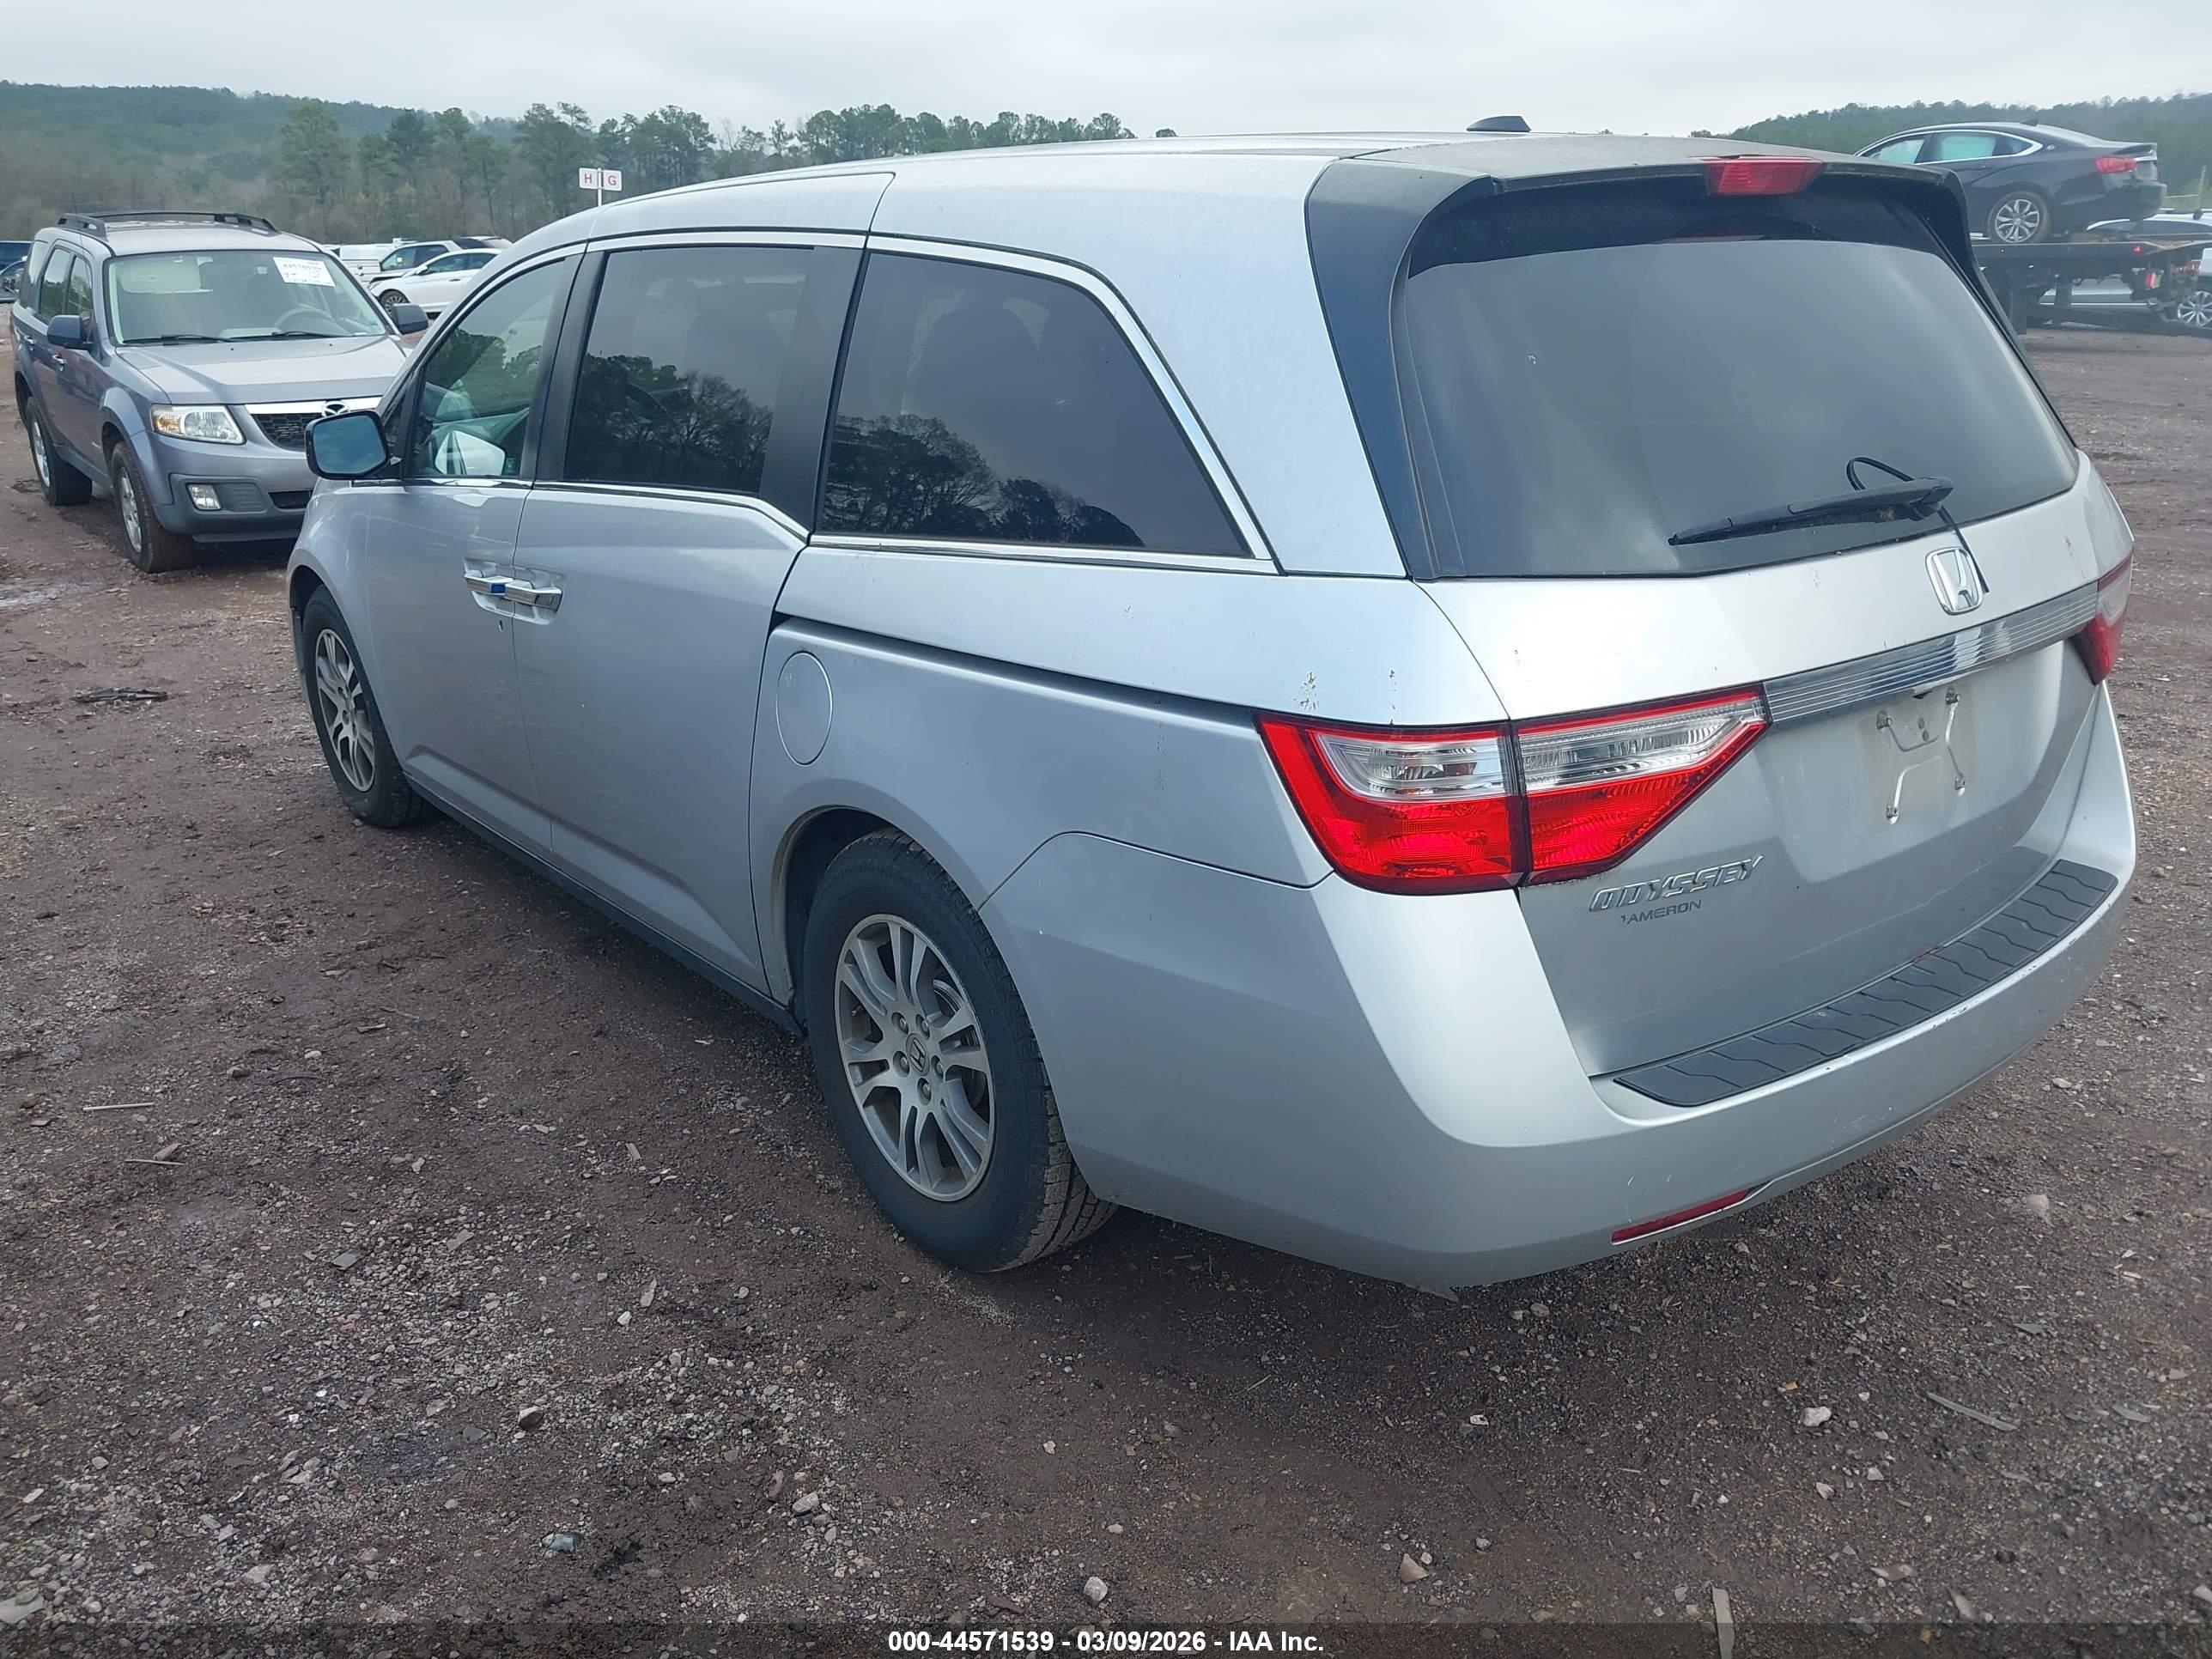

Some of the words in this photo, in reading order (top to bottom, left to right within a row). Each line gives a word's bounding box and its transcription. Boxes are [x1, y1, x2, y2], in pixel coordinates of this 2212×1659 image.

[584, 173, 592, 185] H
[608, 174, 617, 186] G
[1589, 855, 1764, 912] ODYSSEY
